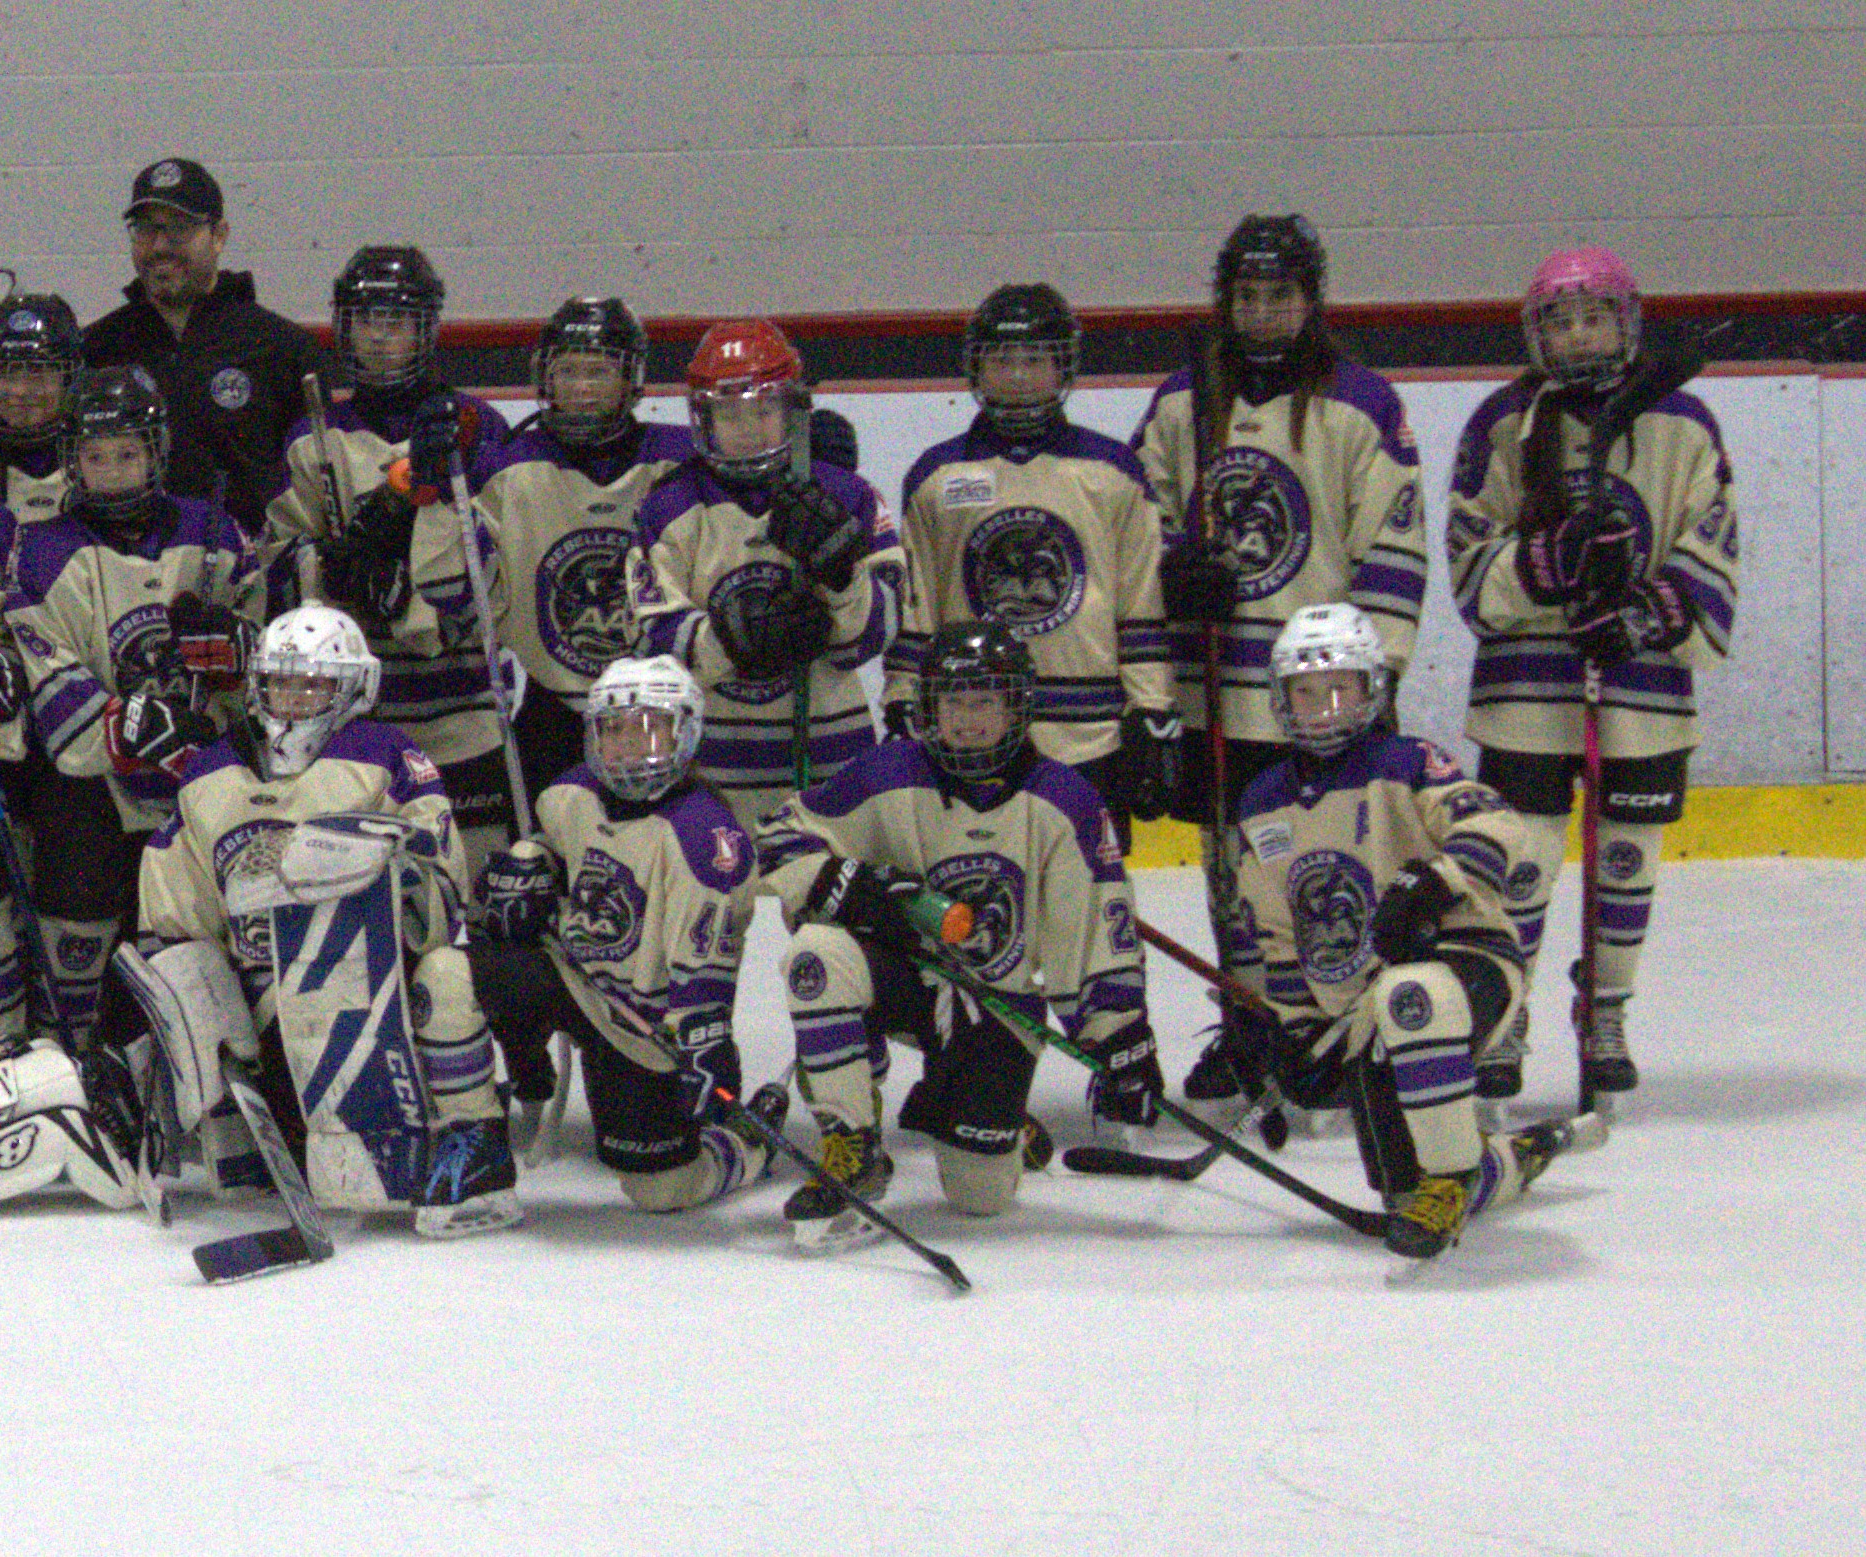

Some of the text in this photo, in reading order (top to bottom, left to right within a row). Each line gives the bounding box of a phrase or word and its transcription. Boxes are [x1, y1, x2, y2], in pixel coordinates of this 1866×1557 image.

[721, 340, 743, 358] 11
[1608, 790, 1674, 809] CCM
[564, 909, 619, 935] AA
[1103, 897, 1141, 955] 2
[384, 1047, 425, 1129] CCM
[954, 1123, 1017, 1143] CCM
